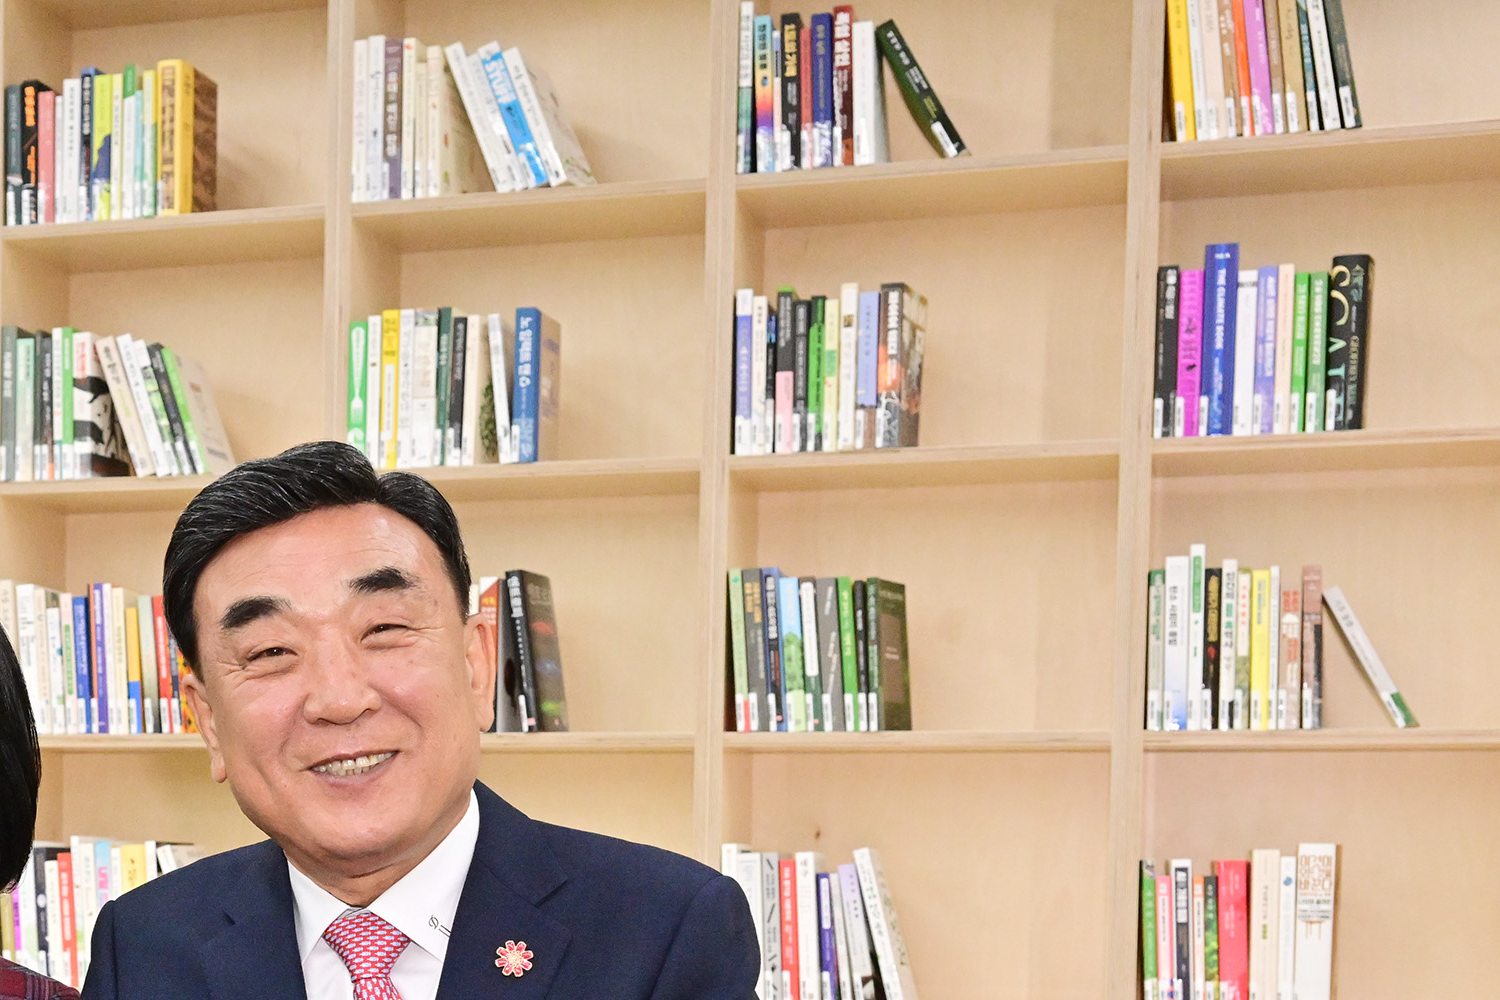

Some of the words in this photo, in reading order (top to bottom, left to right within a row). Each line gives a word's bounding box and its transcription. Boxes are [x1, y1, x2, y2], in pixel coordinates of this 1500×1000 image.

[1215, 286, 1226, 325] CLIMATE
[518, 329, 533, 363] 임팩트
[1215, 325, 1225, 350] BOOK
[518, 363, 531, 376] 맨
